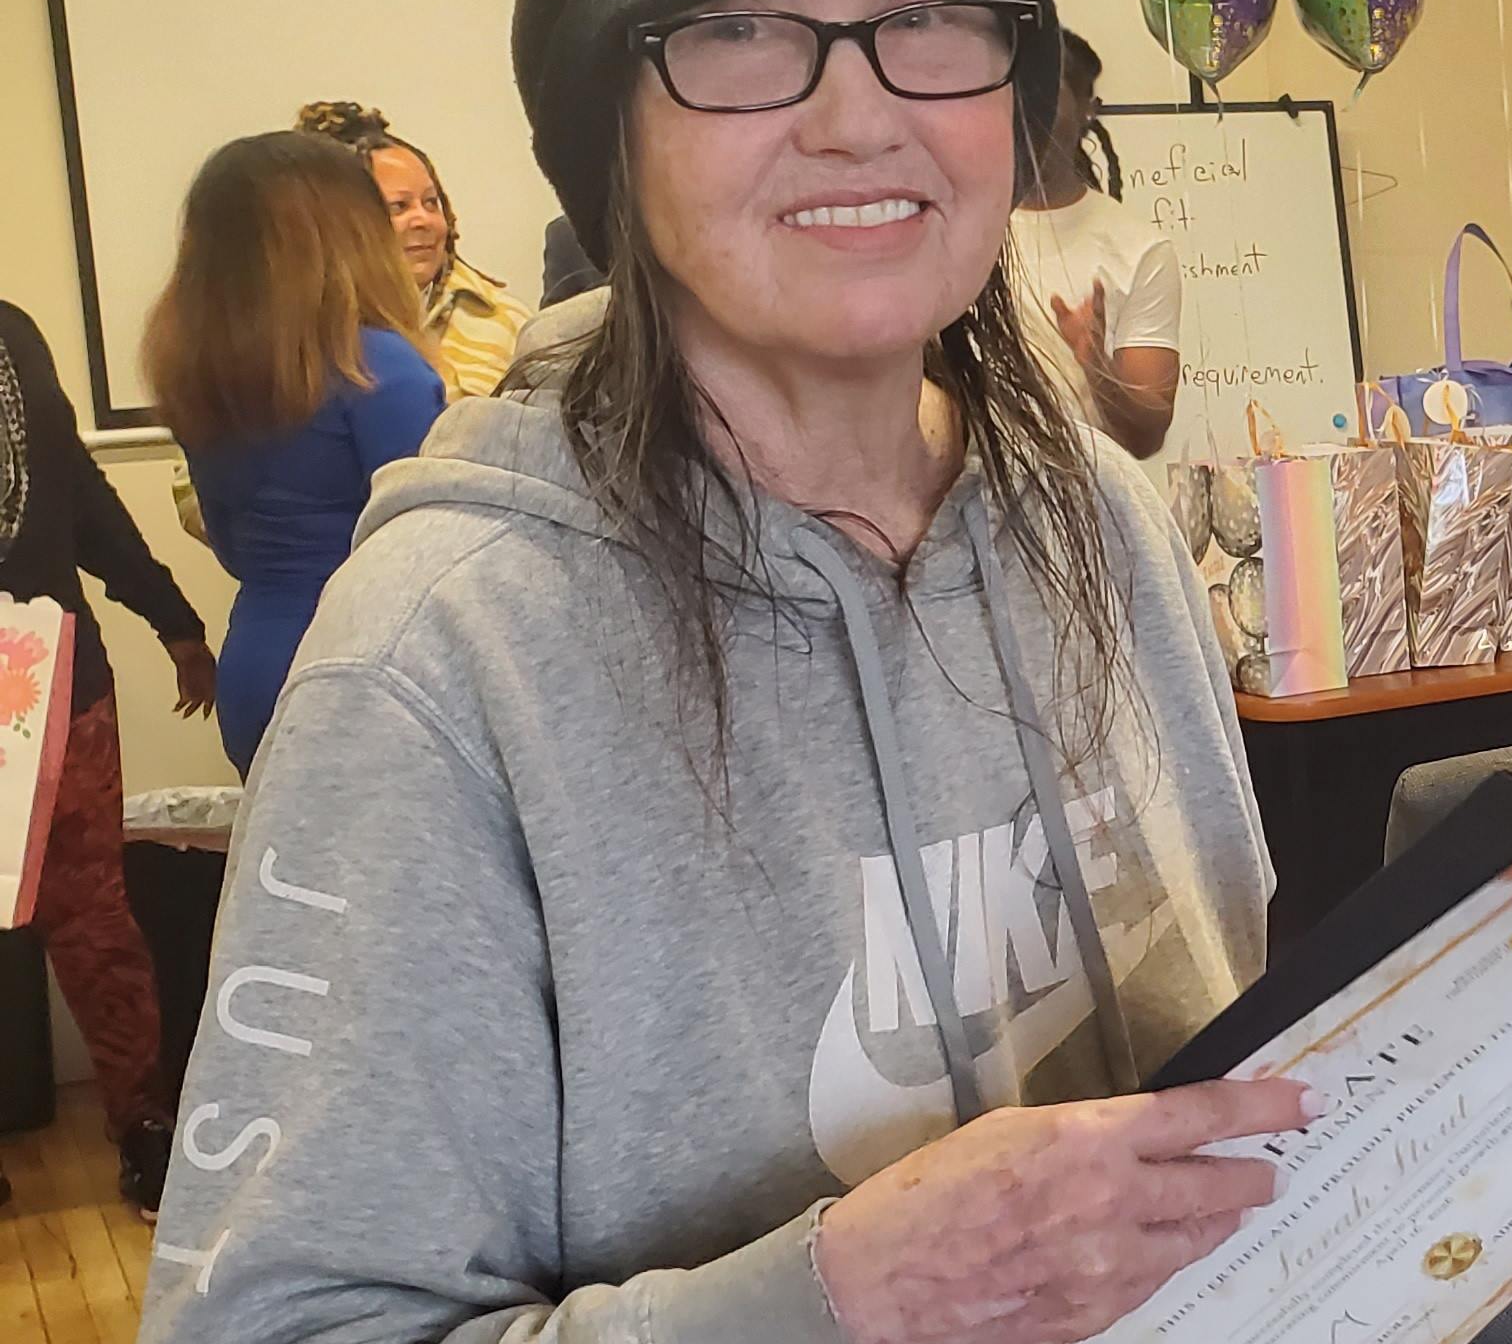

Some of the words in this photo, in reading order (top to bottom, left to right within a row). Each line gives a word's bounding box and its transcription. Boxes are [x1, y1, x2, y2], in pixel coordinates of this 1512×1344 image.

[1181, 242, 1269, 279] ishment
[1182, 346, 1324, 397] requirement.
[859, 785, 1119, 1032] NIKE
[155, 846, 348, 1294] JUST
[1194, 1208, 1300, 1302] CERTIFICATE
[1320, 1122, 1394, 1194] PROUDLY
